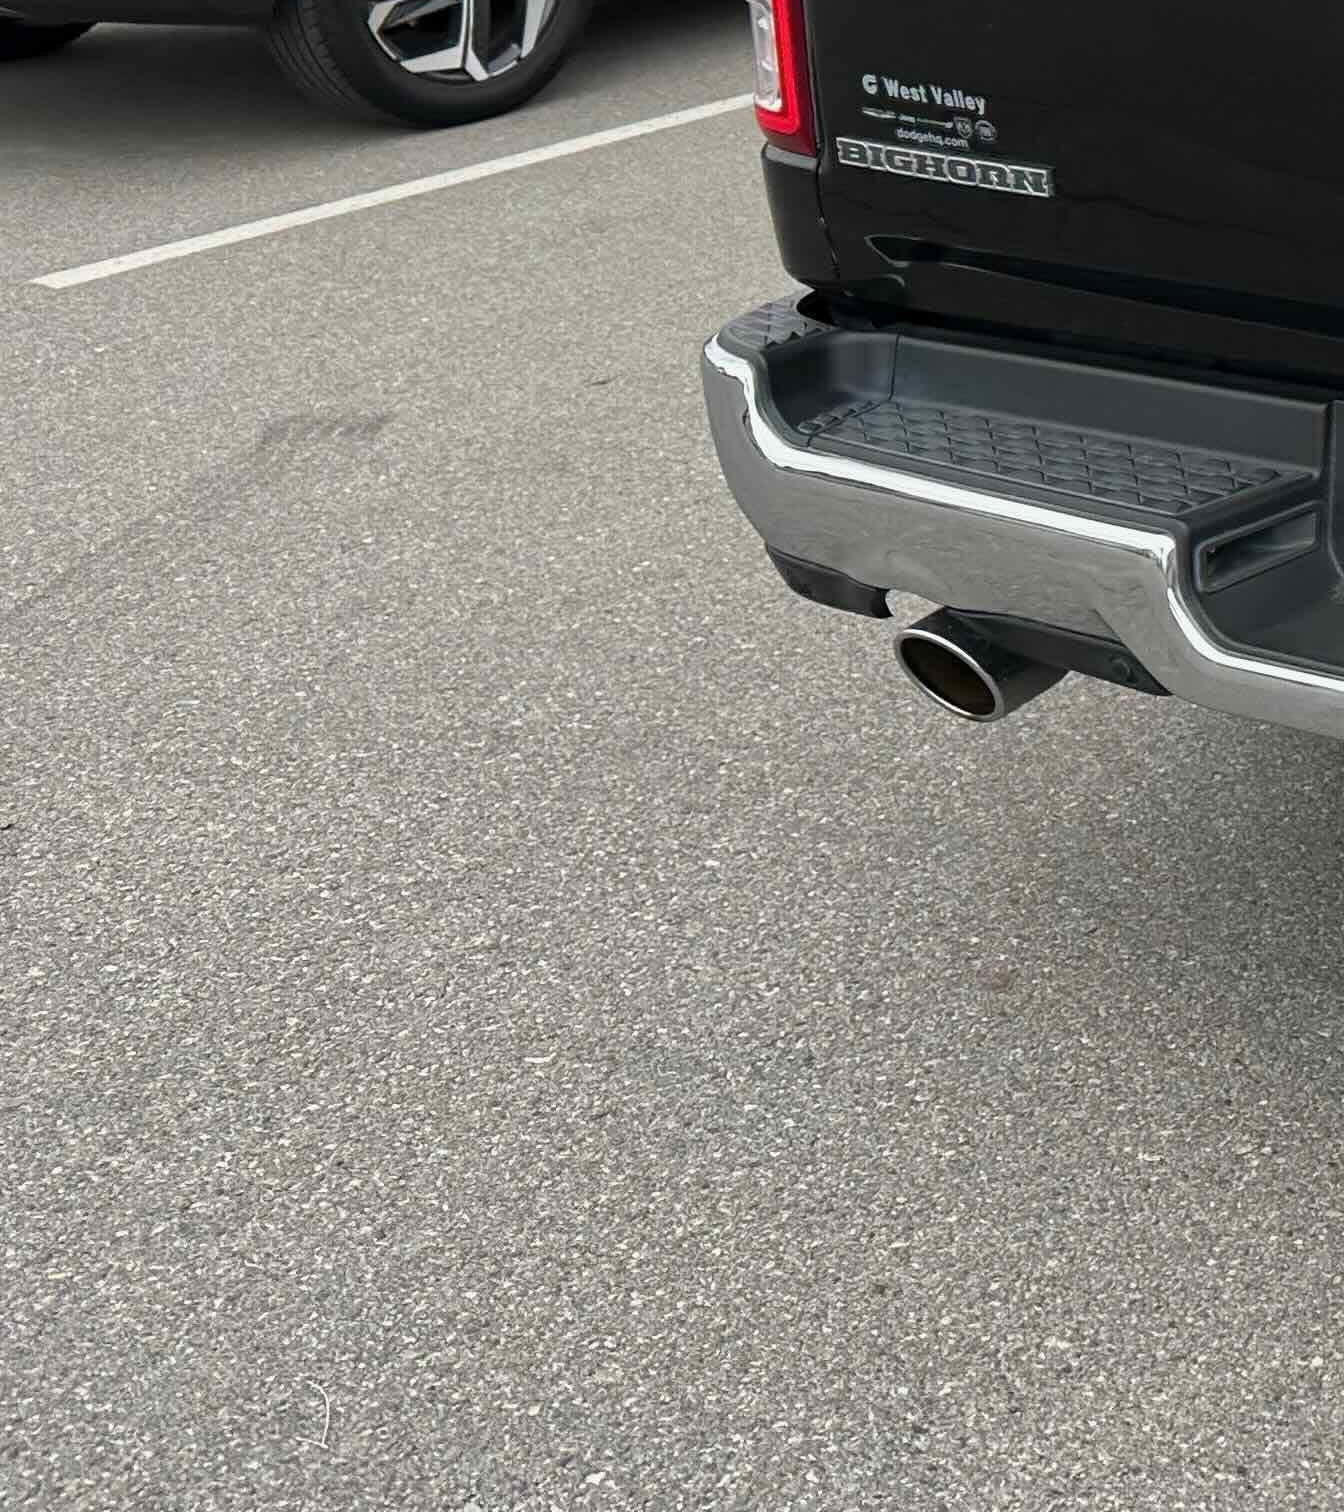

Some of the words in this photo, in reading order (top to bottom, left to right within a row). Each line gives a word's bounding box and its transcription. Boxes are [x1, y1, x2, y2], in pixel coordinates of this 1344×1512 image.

[881, 76, 928, 103] West
[929, 85, 986, 116] Valley
[836, 137, 1055, 197] BIGHORN
